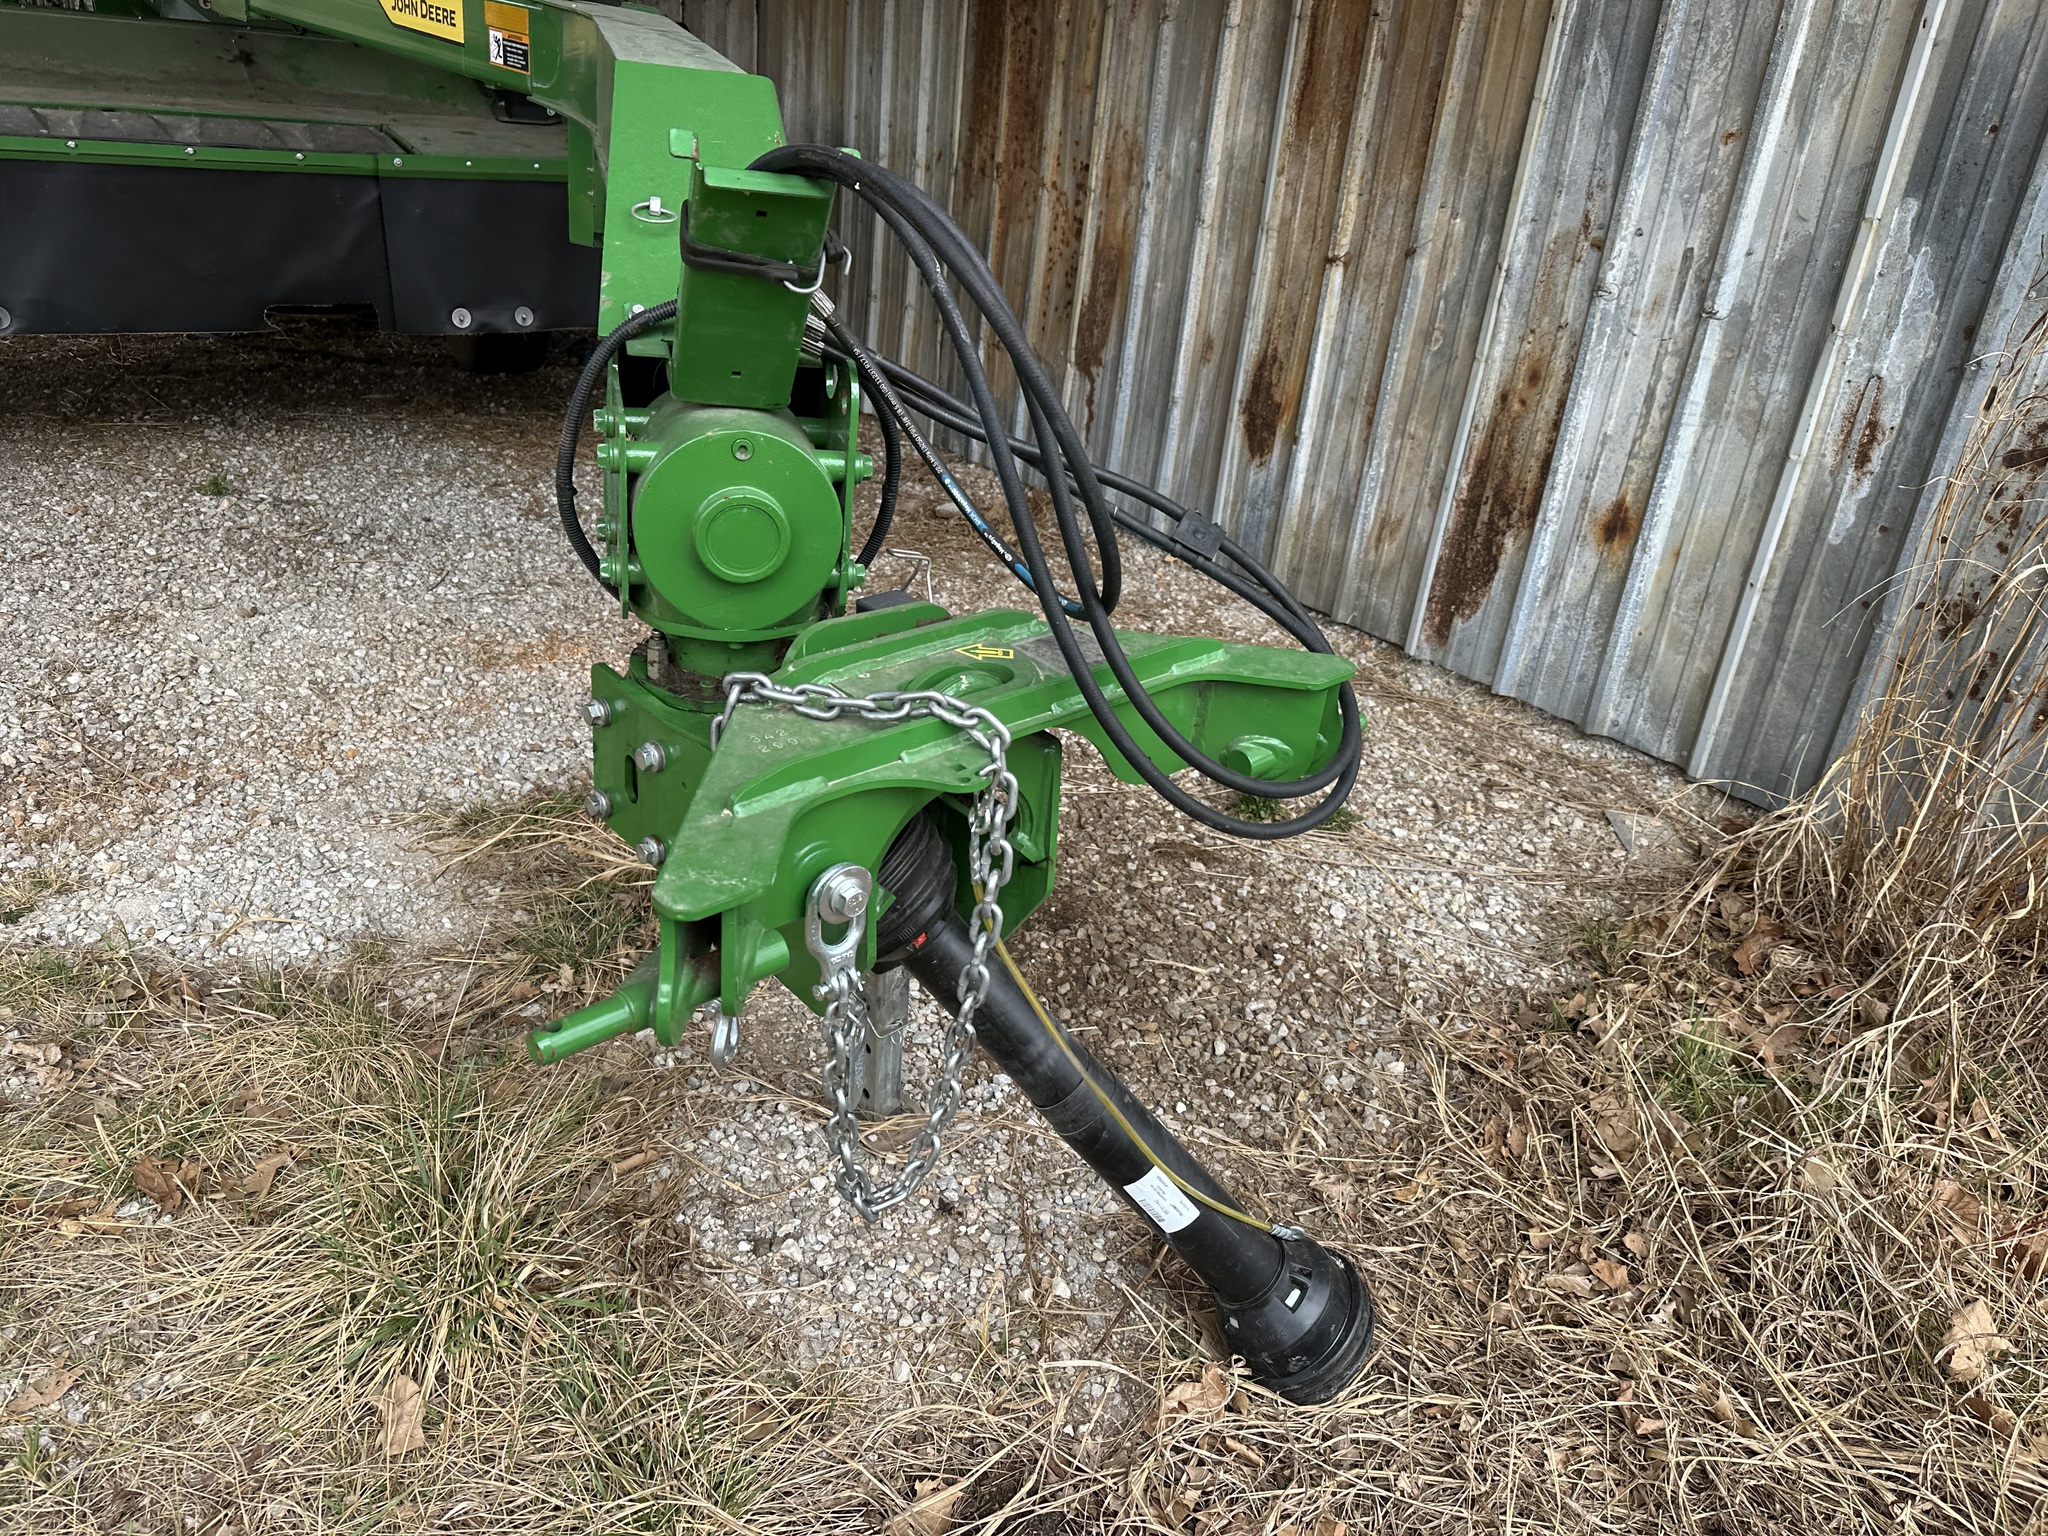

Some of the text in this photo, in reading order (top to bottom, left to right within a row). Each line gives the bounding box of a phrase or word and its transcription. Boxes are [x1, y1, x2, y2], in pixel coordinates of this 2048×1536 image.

[391, 0, 457, 28] JOHN DEERE
[859, 356, 871, 369] R17
[867, 366, 882, 385] 11237
[878, 382, 888, 394] ISO
[914, 435, 929, 453] (3250
[924, 450, 935, 463] MPa
[931, 460, 943, 474] 22.5
[749, 729, 788, 743] 342
